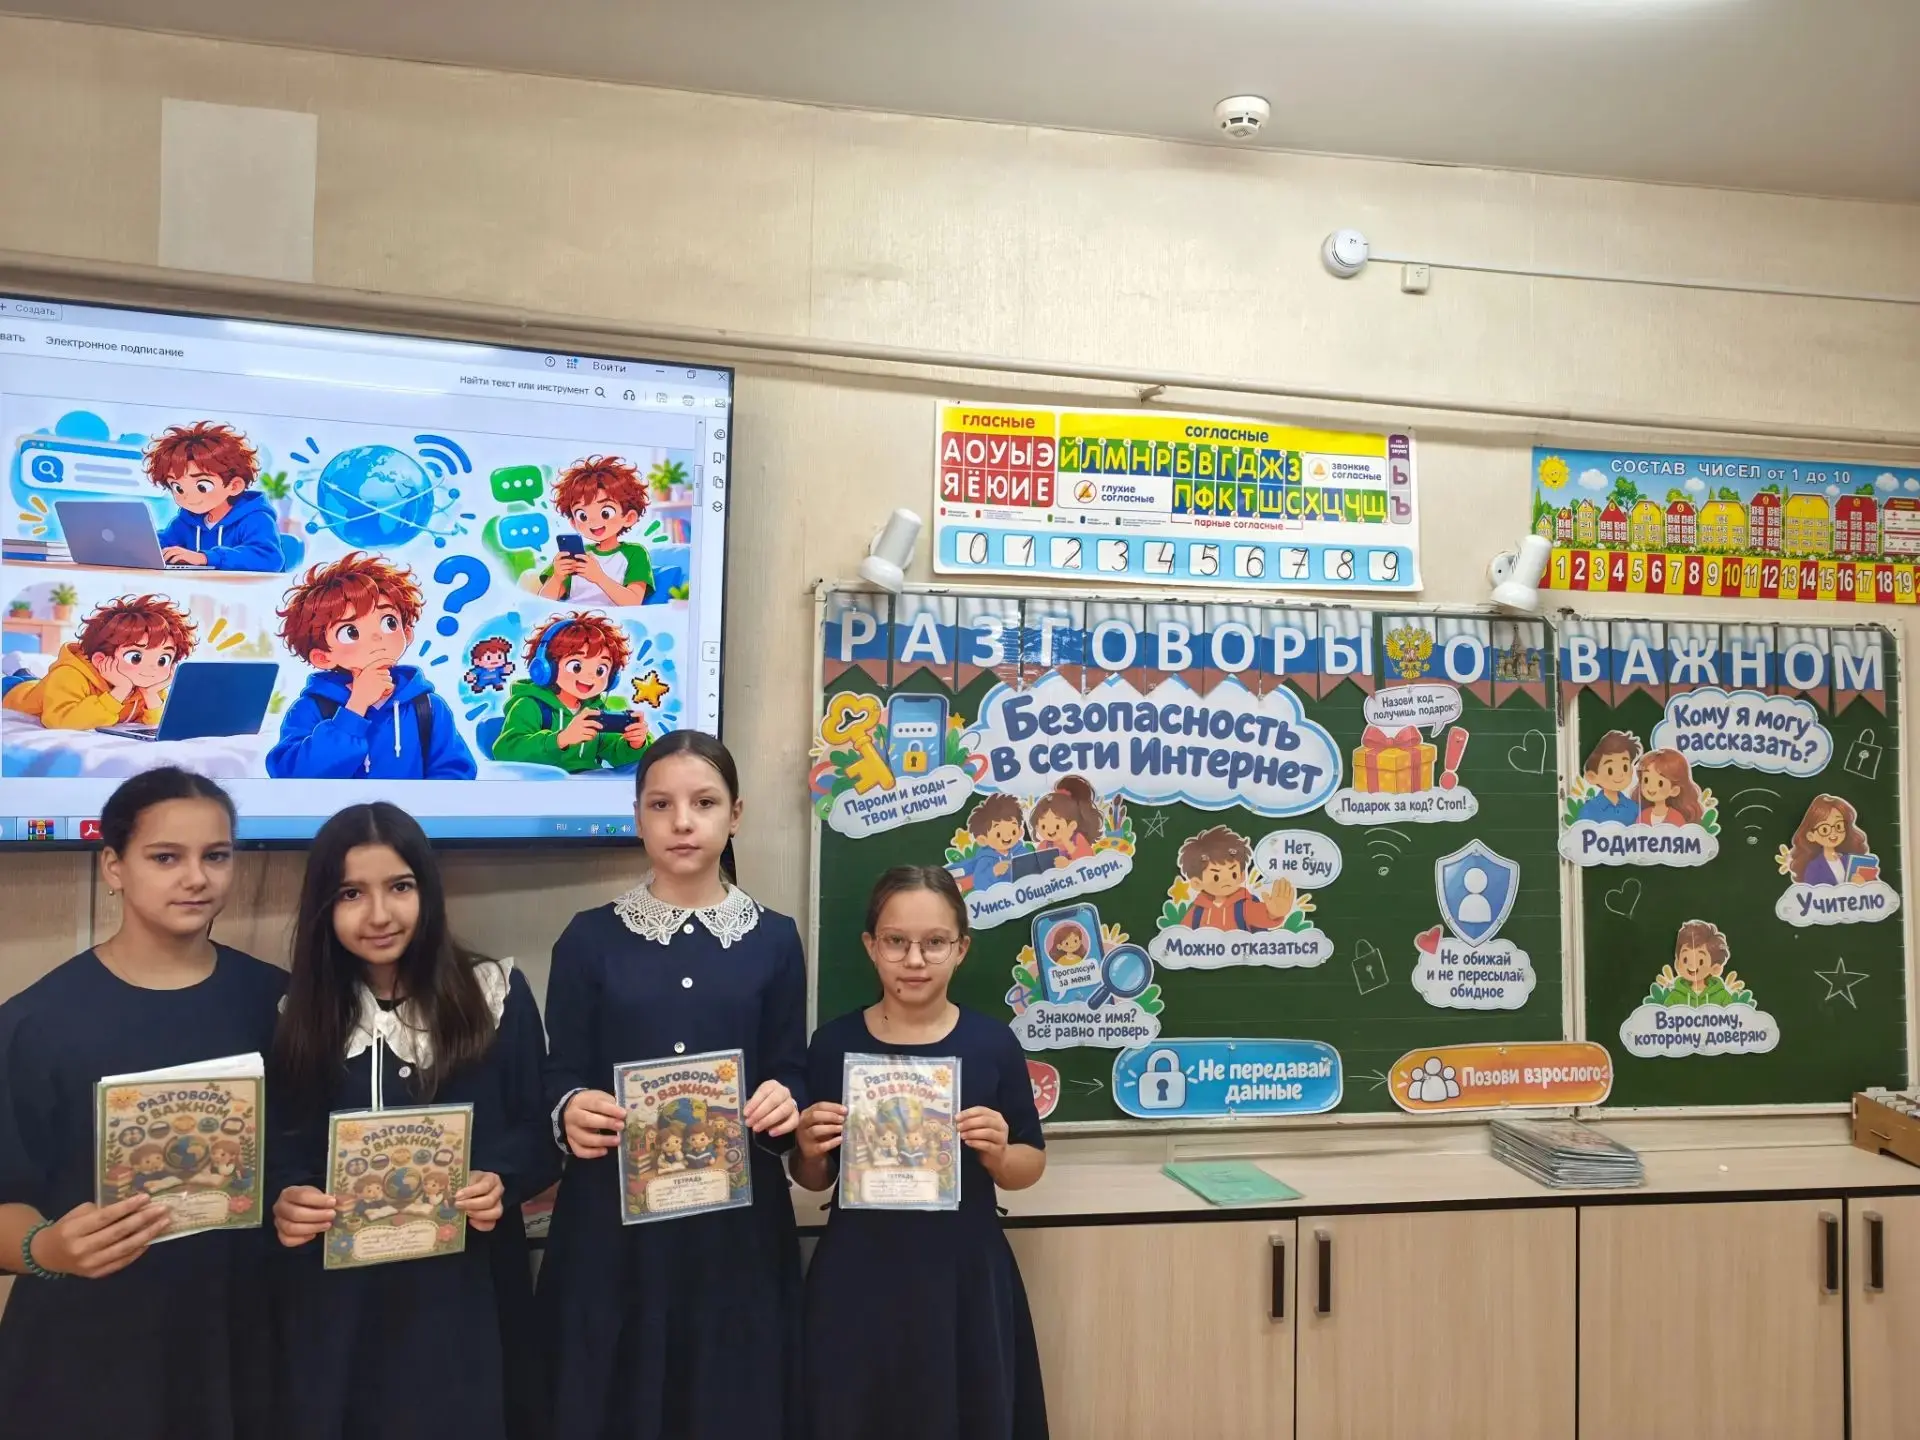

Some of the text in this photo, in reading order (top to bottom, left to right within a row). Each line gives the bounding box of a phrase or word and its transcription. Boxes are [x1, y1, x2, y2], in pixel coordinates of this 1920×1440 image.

[15, 303, 56, 317] Создать
[45, 335, 184, 358] Электронное подписание
[592, 361, 627, 374] Войти
[459, 374, 590, 396] Найти текст или инструмент
[961, 412, 1036, 430] гласные
[1185, 424, 1270, 443] согласные
[1331, 463, 1370, 472] звонкие
[1331, 471, 1382, 481] согласные
[1610, 458, 1850, 484] СОСТАВ ЧИСЕЛ от 1 до 10
[1101, 484, 1136, 495] глухие
[1101, 493, 1155, 504] согласные
[1194, 518, 1284, 531] парные согласные
[969, 533, 1398, 581] 0 1 2 3 4 5 6 7 8 9
[1556, 556, 1566, 580] 1
[1574, 557, 1586, 580] 2
[1594, 557, 1605, 581] 3
[1612, 558, 1625, 582] 4
[1632, 559, 1643, 583] 5
[1651, 560, 1663, 583] 6
[1670, 561, 1682, 584] 7
[1688, 562, 1700, 585] 8
[1707, 562, 1719, 586] 9
[1724, 563, 1741, 587] 10
[1744, 564, 1759, 589] 11
[1762, 565, 1779, 589] 12
[1781, 566, 1798, 590] 13
[1800, 567, 1817, 591] 14
[1819, 568, 1835, 592] 15
[1838, 568, 1854, 592] 16
[1856, 569, 1873, 593] 17
[1876, 570, 1894, 593] 18
[1895, 571, 1913, 594] 19
[840, 609, 1884, 692] РАЗГОВОРЫ О ВАЖНОМ
[1381, 694, 1434, 709] Назови код
[1373, 704, 1455, 721] получишь подарок
[1673, 704, 1730, 730] Кому
[1754, 709, 1811, 741] могу
[1002, 694, 1301, 752] Безопасность
[1676, 732, 1818, 764] рассказать?
[1029, 740, 1120, 775] сети
[1130, 736, 1323, 795] Интернет
[844, 780, 947, 816] Пароли и коды
[1341, 797, 1468, 814] Подарок за код? Стоп!
[860, 794, 948, 828] твои ключи
[1284, 839, 1315, 857] Нет,
[1581, 829, 1702, 857] Родителям
[1268, 857, 1333, 876] я не буду
[969, 862, 1123, 919] Учись. Общайся. Твори.
[1795, 892, 1885, 917] Учителю
[1165, 938, 1319, 958] Можно отказаться
[1440, 949, 1512, 967] Не обижай
[1052, 962, 1096, 980] Проголосуй
[1059, 974, 1092, 988] за меня
[1427, 968, 1525, 986] и не пересылай
[1449, 984, 1505, 1001] обидное
[1036, 1009, 1138, 1026] Знакомое имя?
[1655, 1011, 1744, 1032] Взрослому,
[1026, 1024, 1150, 1042] Всё равно проверь
[1634, 1029, 1768, 1049] которому доверяю
[640, 1070, 721, 1094] Разговоры
[1198, 1058, 1332, 1086] Не передавай
[1462, 1065, 1602, 1090] Позови взрослого
[136, 1090, 231, 1113] РАЗГОВОРЫ
[1225, 1083, 1303, 1104] данные
[151, 1101, 231, 1119] ВАЖНОМ
[362, 1124, 445, 1146] РАЗГОВОРЫ
[373, 1135, 442, 1151] ВАЖНОМ
